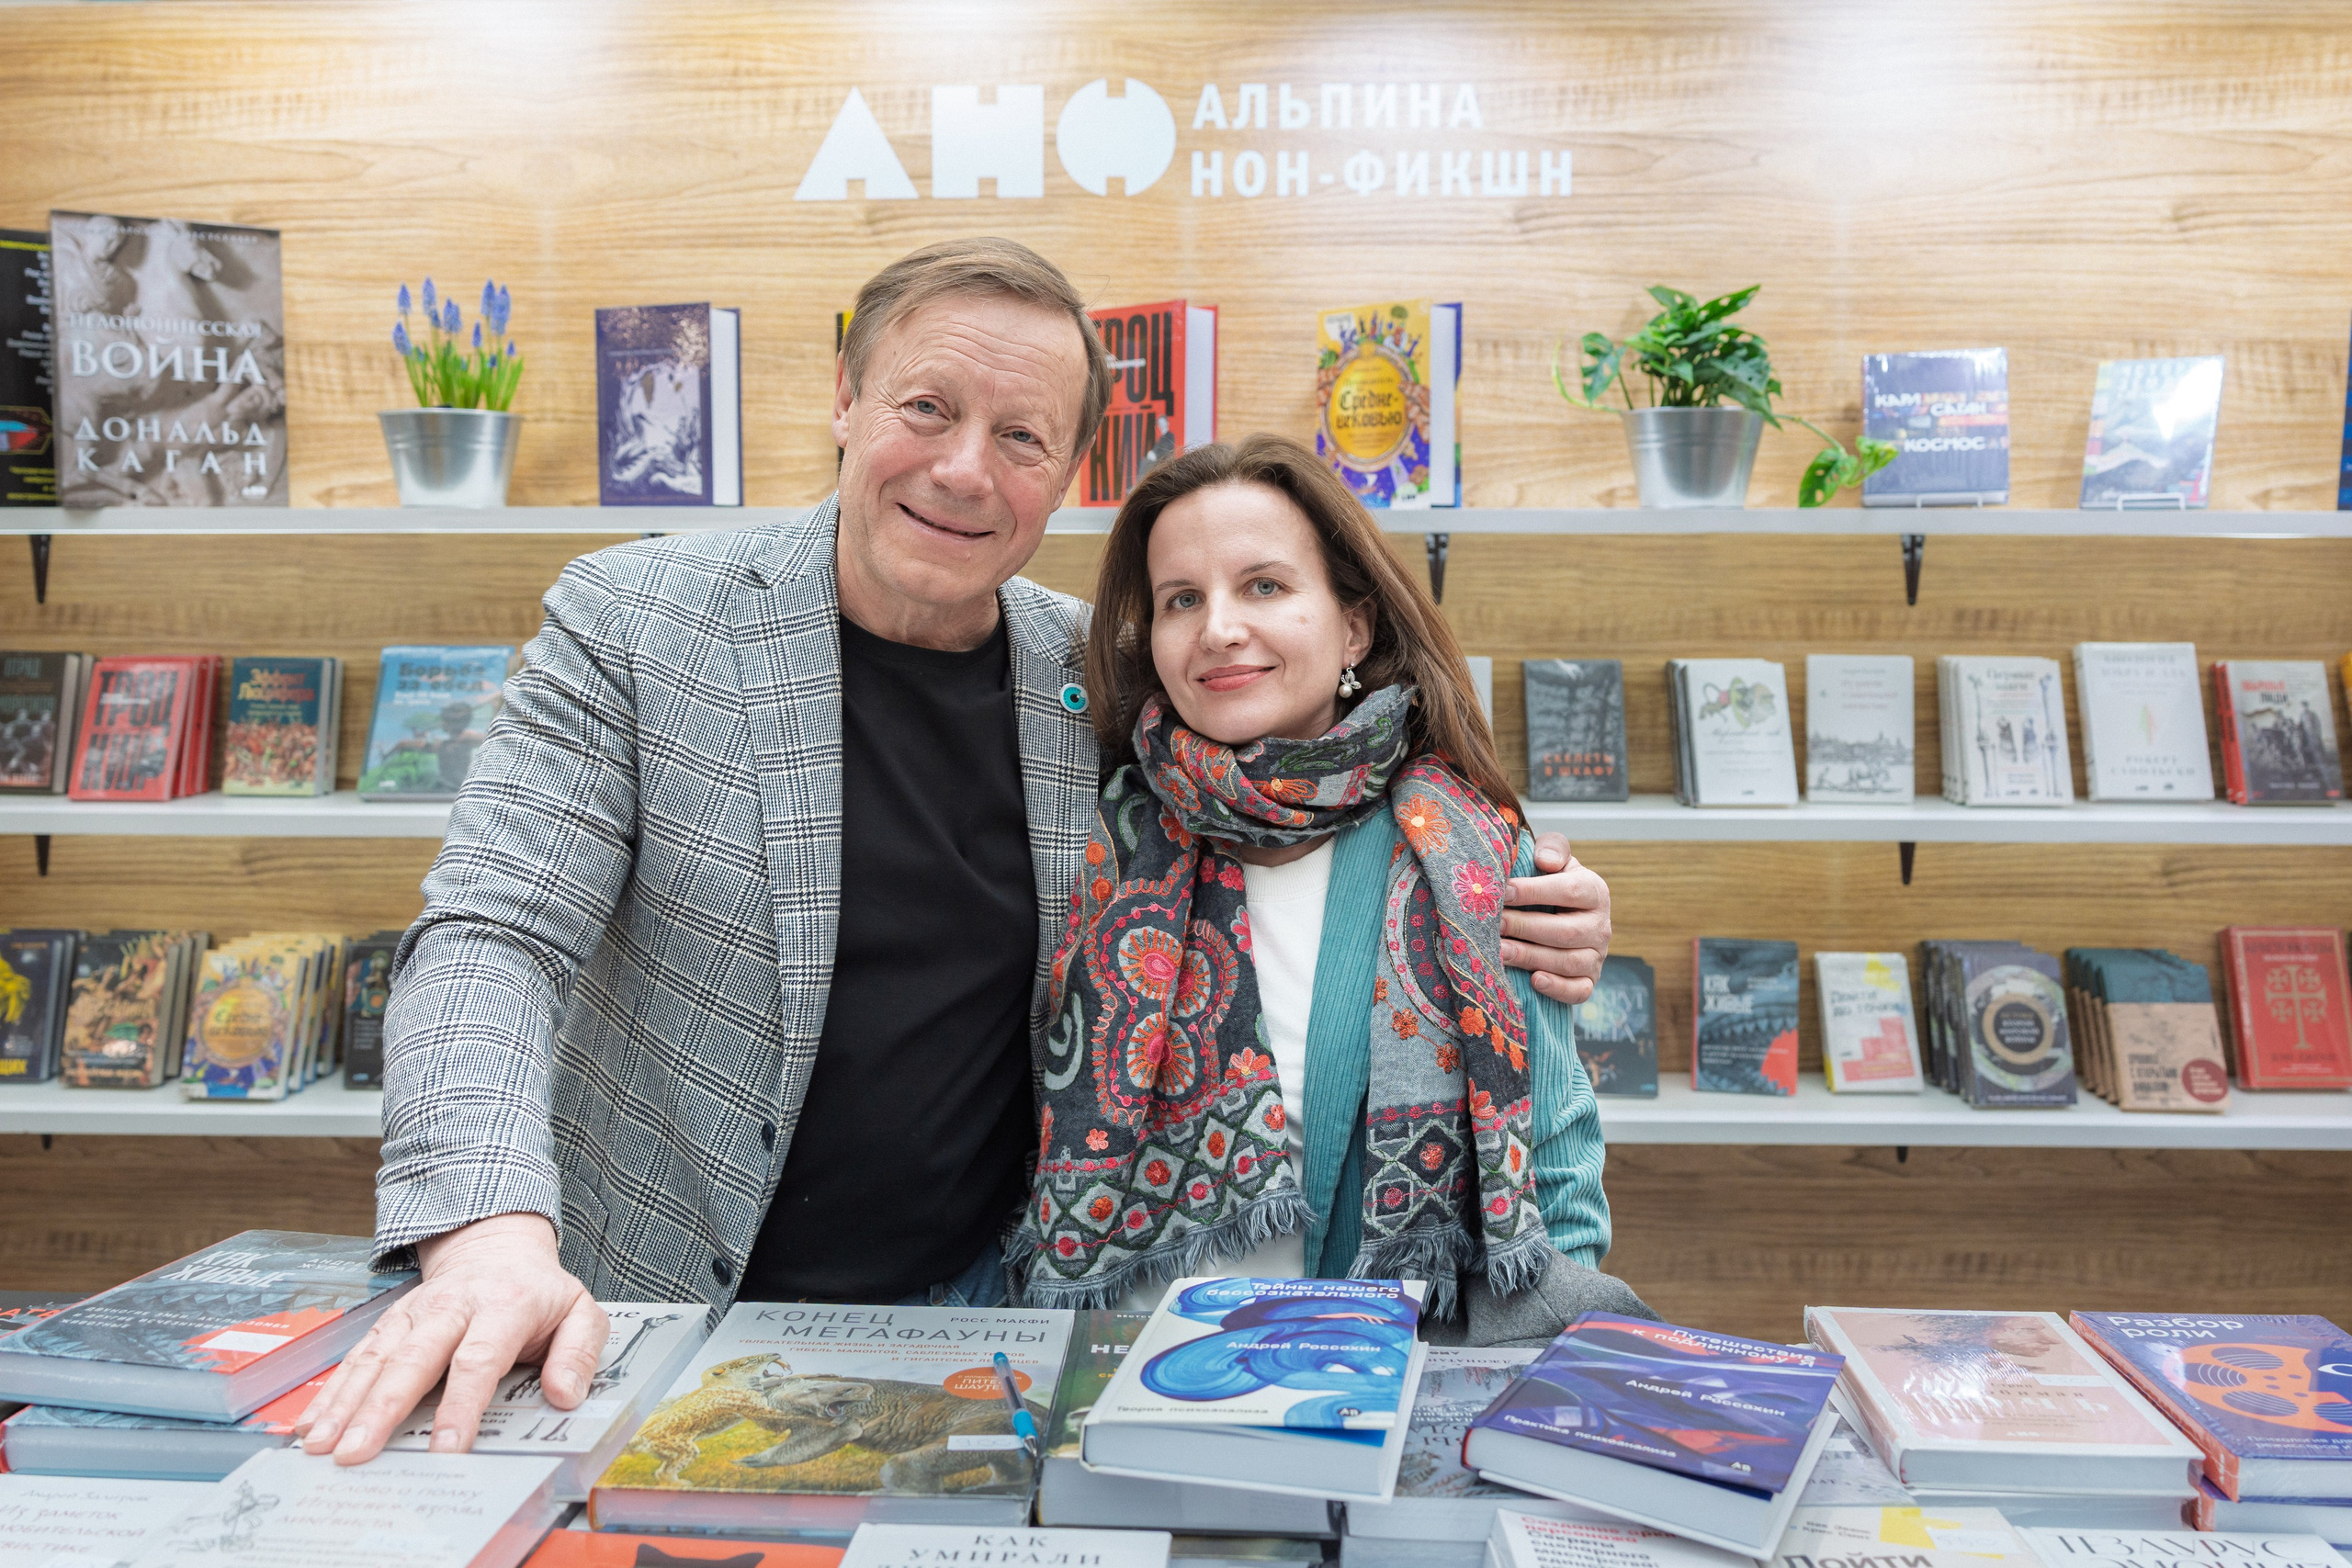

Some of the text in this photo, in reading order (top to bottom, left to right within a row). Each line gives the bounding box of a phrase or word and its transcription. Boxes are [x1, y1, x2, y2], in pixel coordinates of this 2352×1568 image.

[1192, 82, 1485, 131] АЛЬПИНА
[1191, 150, 1574, 198] НОН-ФИКШН
[72, 336, 266, 385] ВОЙНА
[1094, 311, 1174, 417] РОЦ
[74, 416, 268, 446] ДОНАЛЬД
[1904, 435, 1986, 453] КОСМОС
[76, 447, 267, 476] КАГАН
[1558, 766, 1615, 777] ШКАФУ
[193, 1250, 272, 1269] КАК
[308, 1258, 368, 1267] АНДРЕ
[159, 1264, 296, 1288] ЖИВЫЕ
[1206, 1290, 1399, 1300] бессознательного
[1250, 1281, 1400, 1293] Тайны нашего
[85, 1306, 150, 1315] ДВУНОГИЕ
[85, 1314, 134, 1322] ДРУГИЕ
[755, 1310, 894, 1326] КОНЕЦ
[59, 1319, 131, 1329] ЖИВОТНЫЕ
[2107, 1315, 2245, 1330] Разбор
[782, 1325, 1046, 1343] МЕГАФАУНЫ
[2120, 1328, 2217, 1338] роли
[1226, 1341, 1381, 1353] Андрей Россохин
[1654, 1333, 1788, 1365] подлинному
[1798, 1359, 1815, 1370] Я
[1672, 1329, 1817, 1361] Путешествие
[1625, 1380, 1786, 1417] Андрей Россохин
[1504, 1414, 1678, 1459] Практика психоанализа
[974, 1534, 1048, 1547] КАК
[1527, 1529, 1615, 1550] Секреты
[2047, 1533, 2300, 1560] ТЕЗАУРУС
[909, 1548, 1102, 1566] УМИРАЛИ
